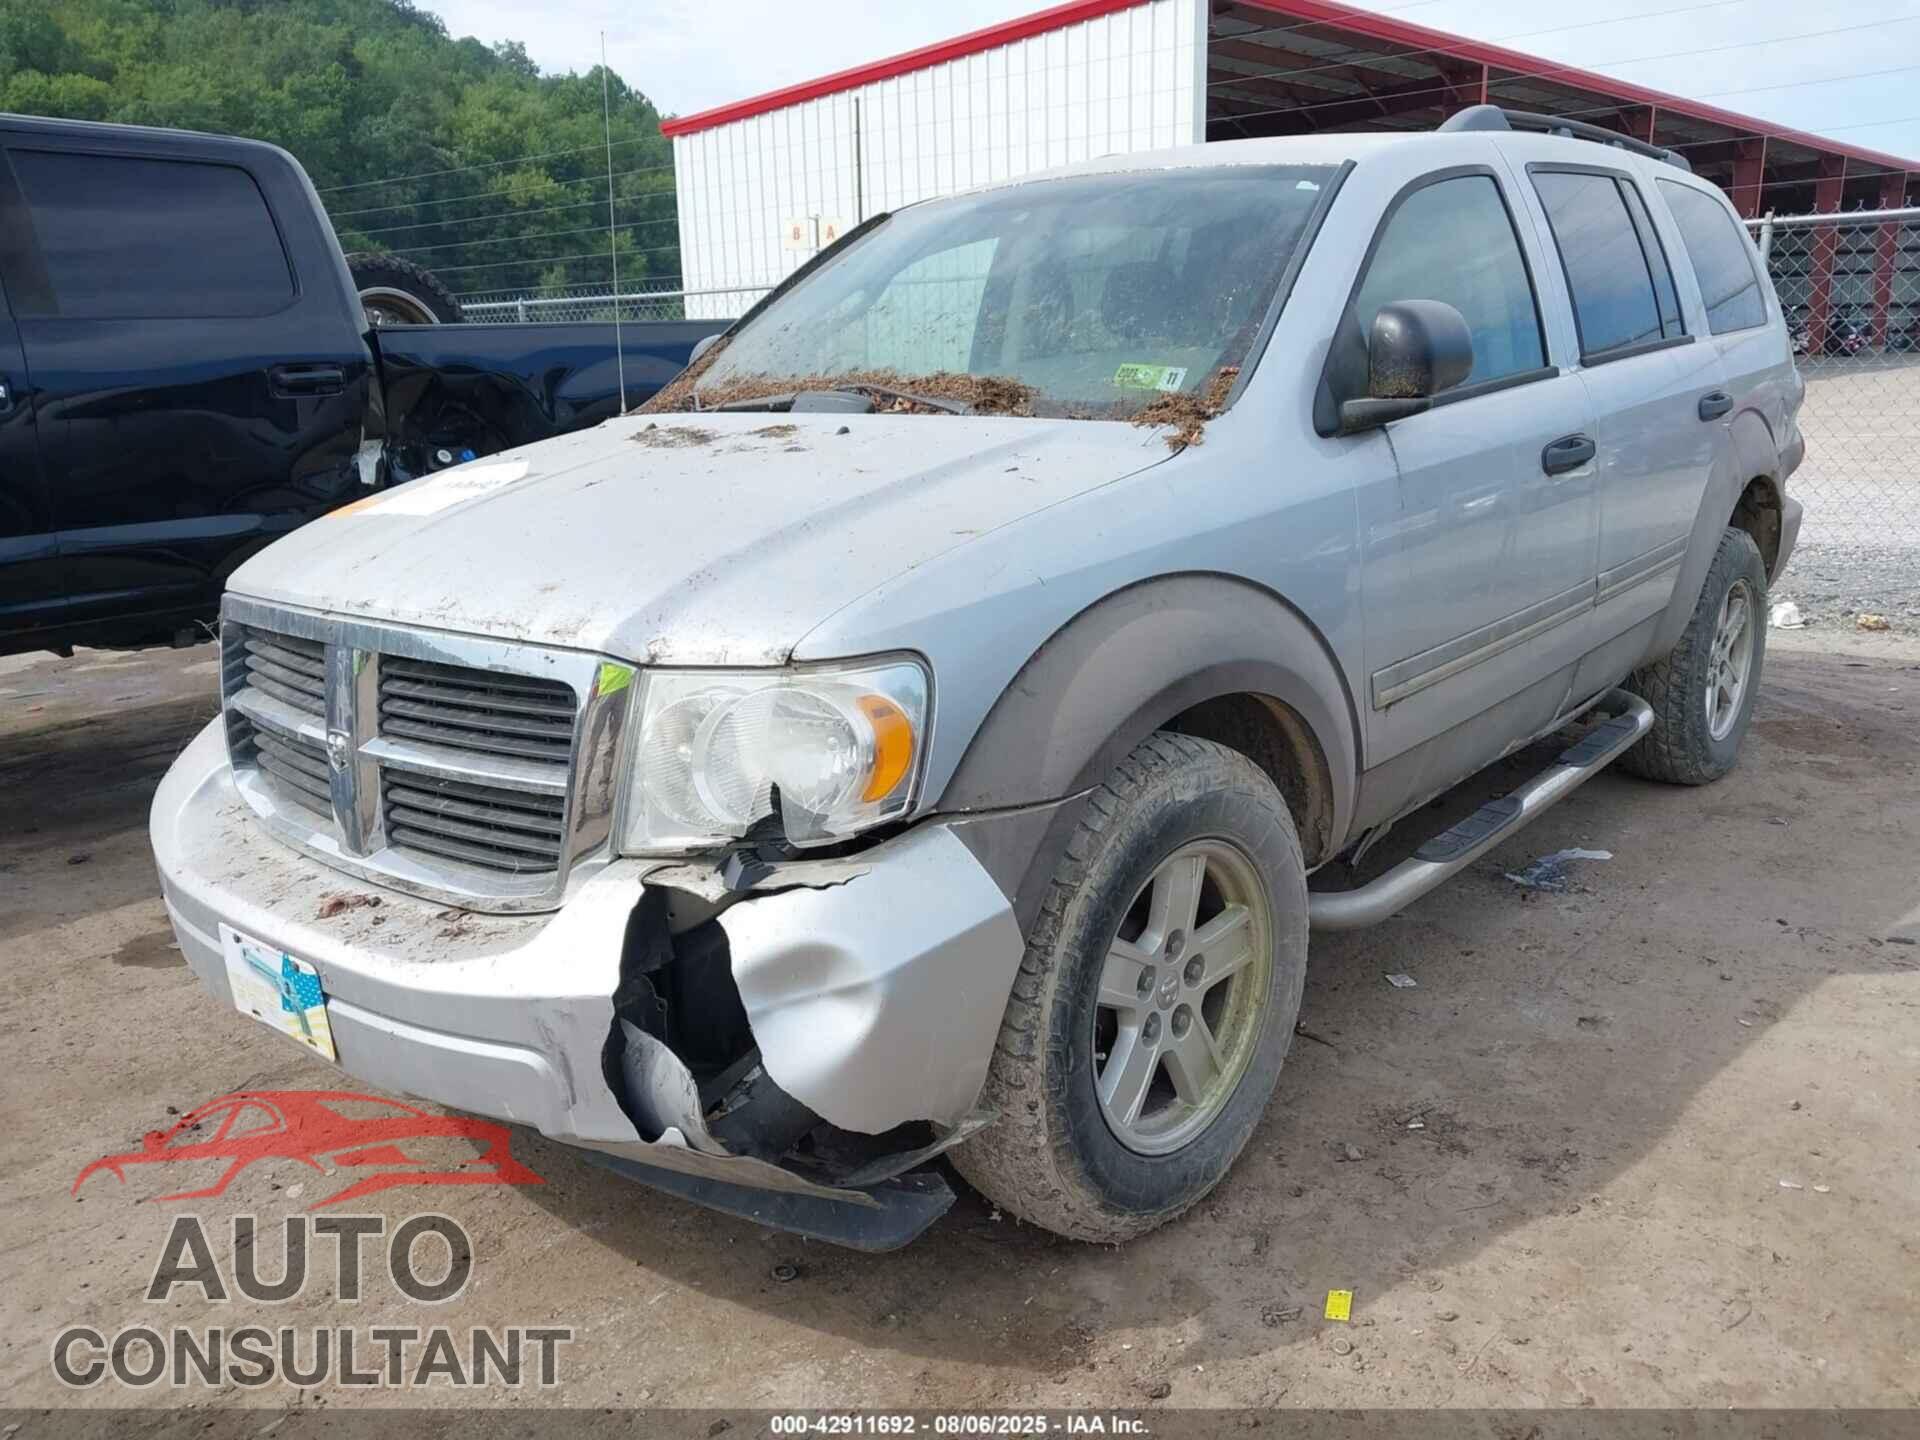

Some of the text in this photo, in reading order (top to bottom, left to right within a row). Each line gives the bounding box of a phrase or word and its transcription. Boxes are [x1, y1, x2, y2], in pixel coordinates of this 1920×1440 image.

[792, 225, 801, 241] B
[826, 224, 835, 240] A
[1166, 371, 1180, 385] 11
